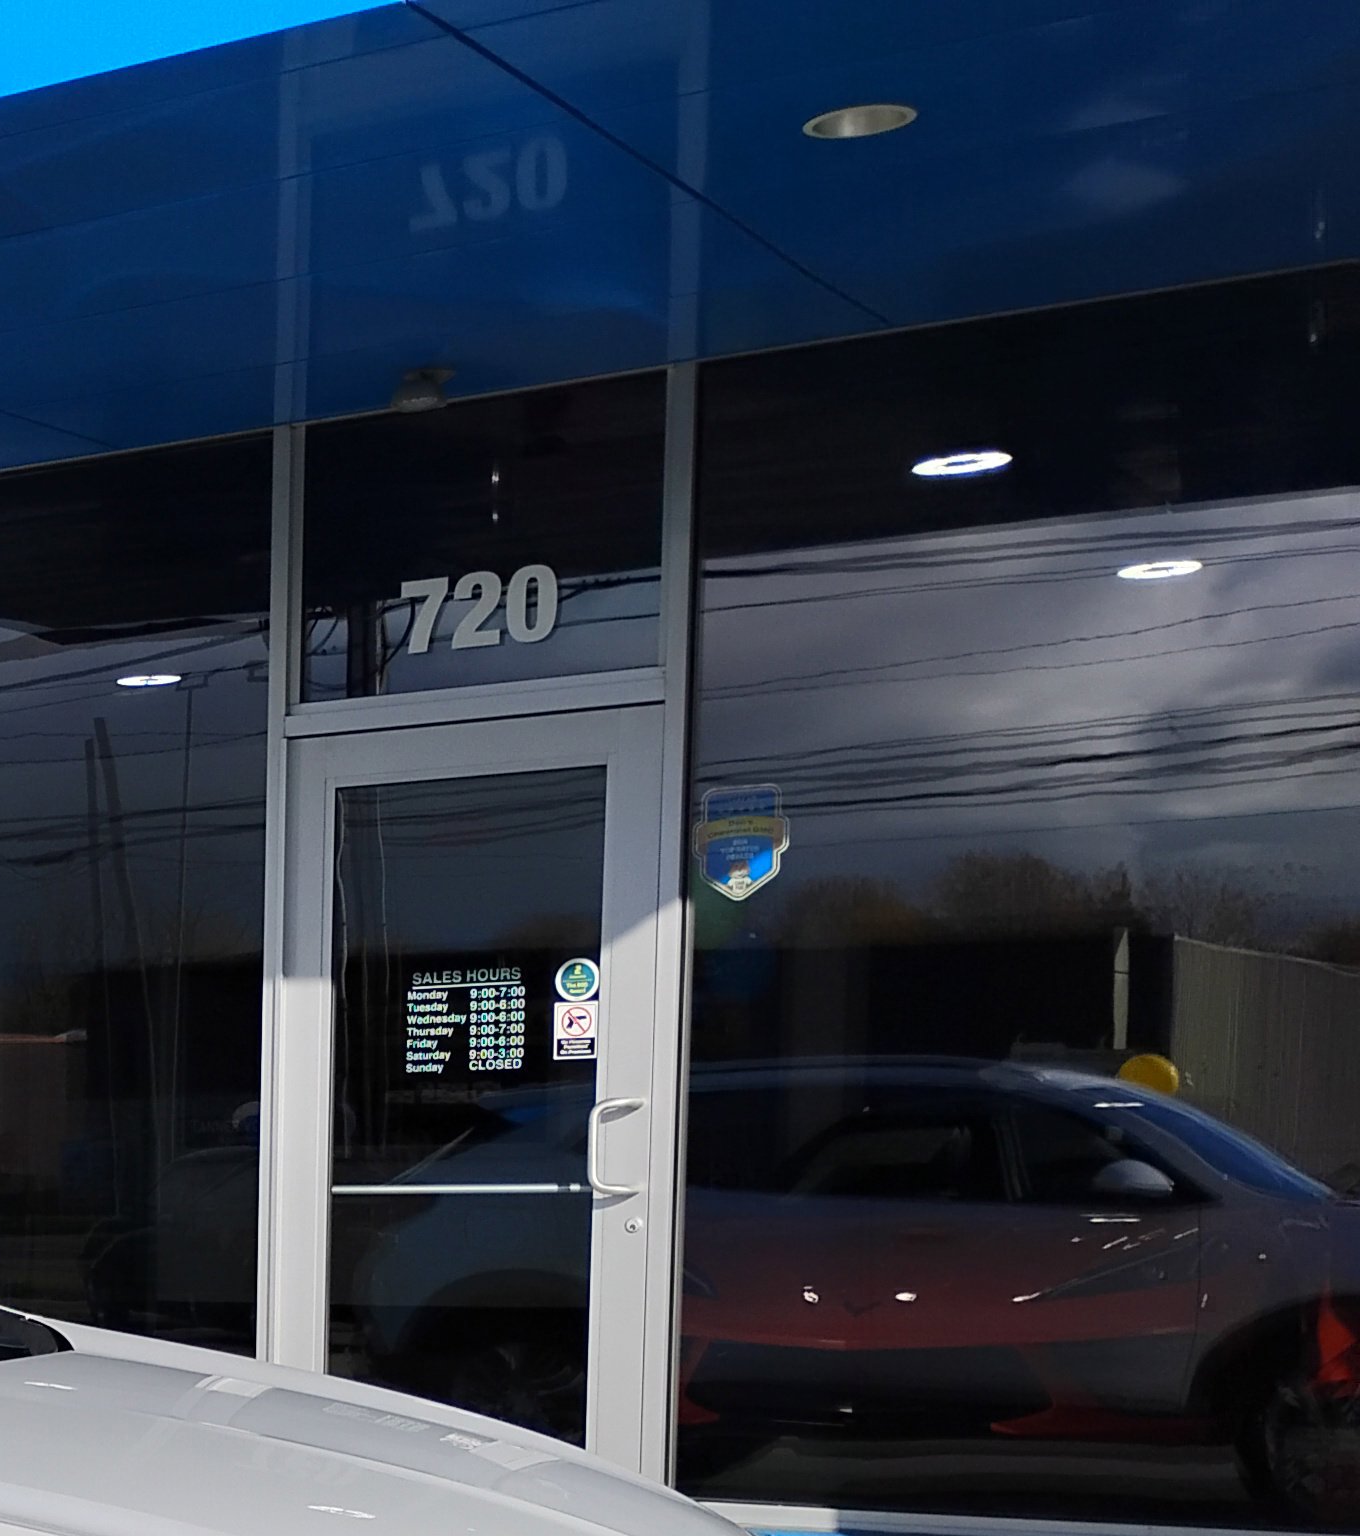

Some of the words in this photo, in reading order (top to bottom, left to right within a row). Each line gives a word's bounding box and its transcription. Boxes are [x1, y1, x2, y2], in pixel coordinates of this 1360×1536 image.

[400, 563, 560, 655] 720
[412, 970, 462, 985] SALES
[466, 967, 522, 982] HOURS
[407, 990, 448, 1001] Monday
[470, 986, 526, 999] 9:00-7:00
[406, 1002, 448, 1013] Tuesday
[470, 998, 525, 1011] 9:00-6:00
[406, 1013, 467, 1024] Wednesday
[469, 1010, 525, 1023] 9:00-6:00
[406, 1026, 454, 1037] Thursday
[469, 1022, 524, 1035] 9:00-7:00
[406, 1039, 438, 1050] Friday
[469, 1035, 524, 1047] 9:00-6:00
[406, 1050, 451, 1061] Saturday
[468, 1047, 524, 1059] 9:00-3:00
[405, 1062, 444, 1074] Sunday
[468, 1058, 522, 1071] CLOSED
